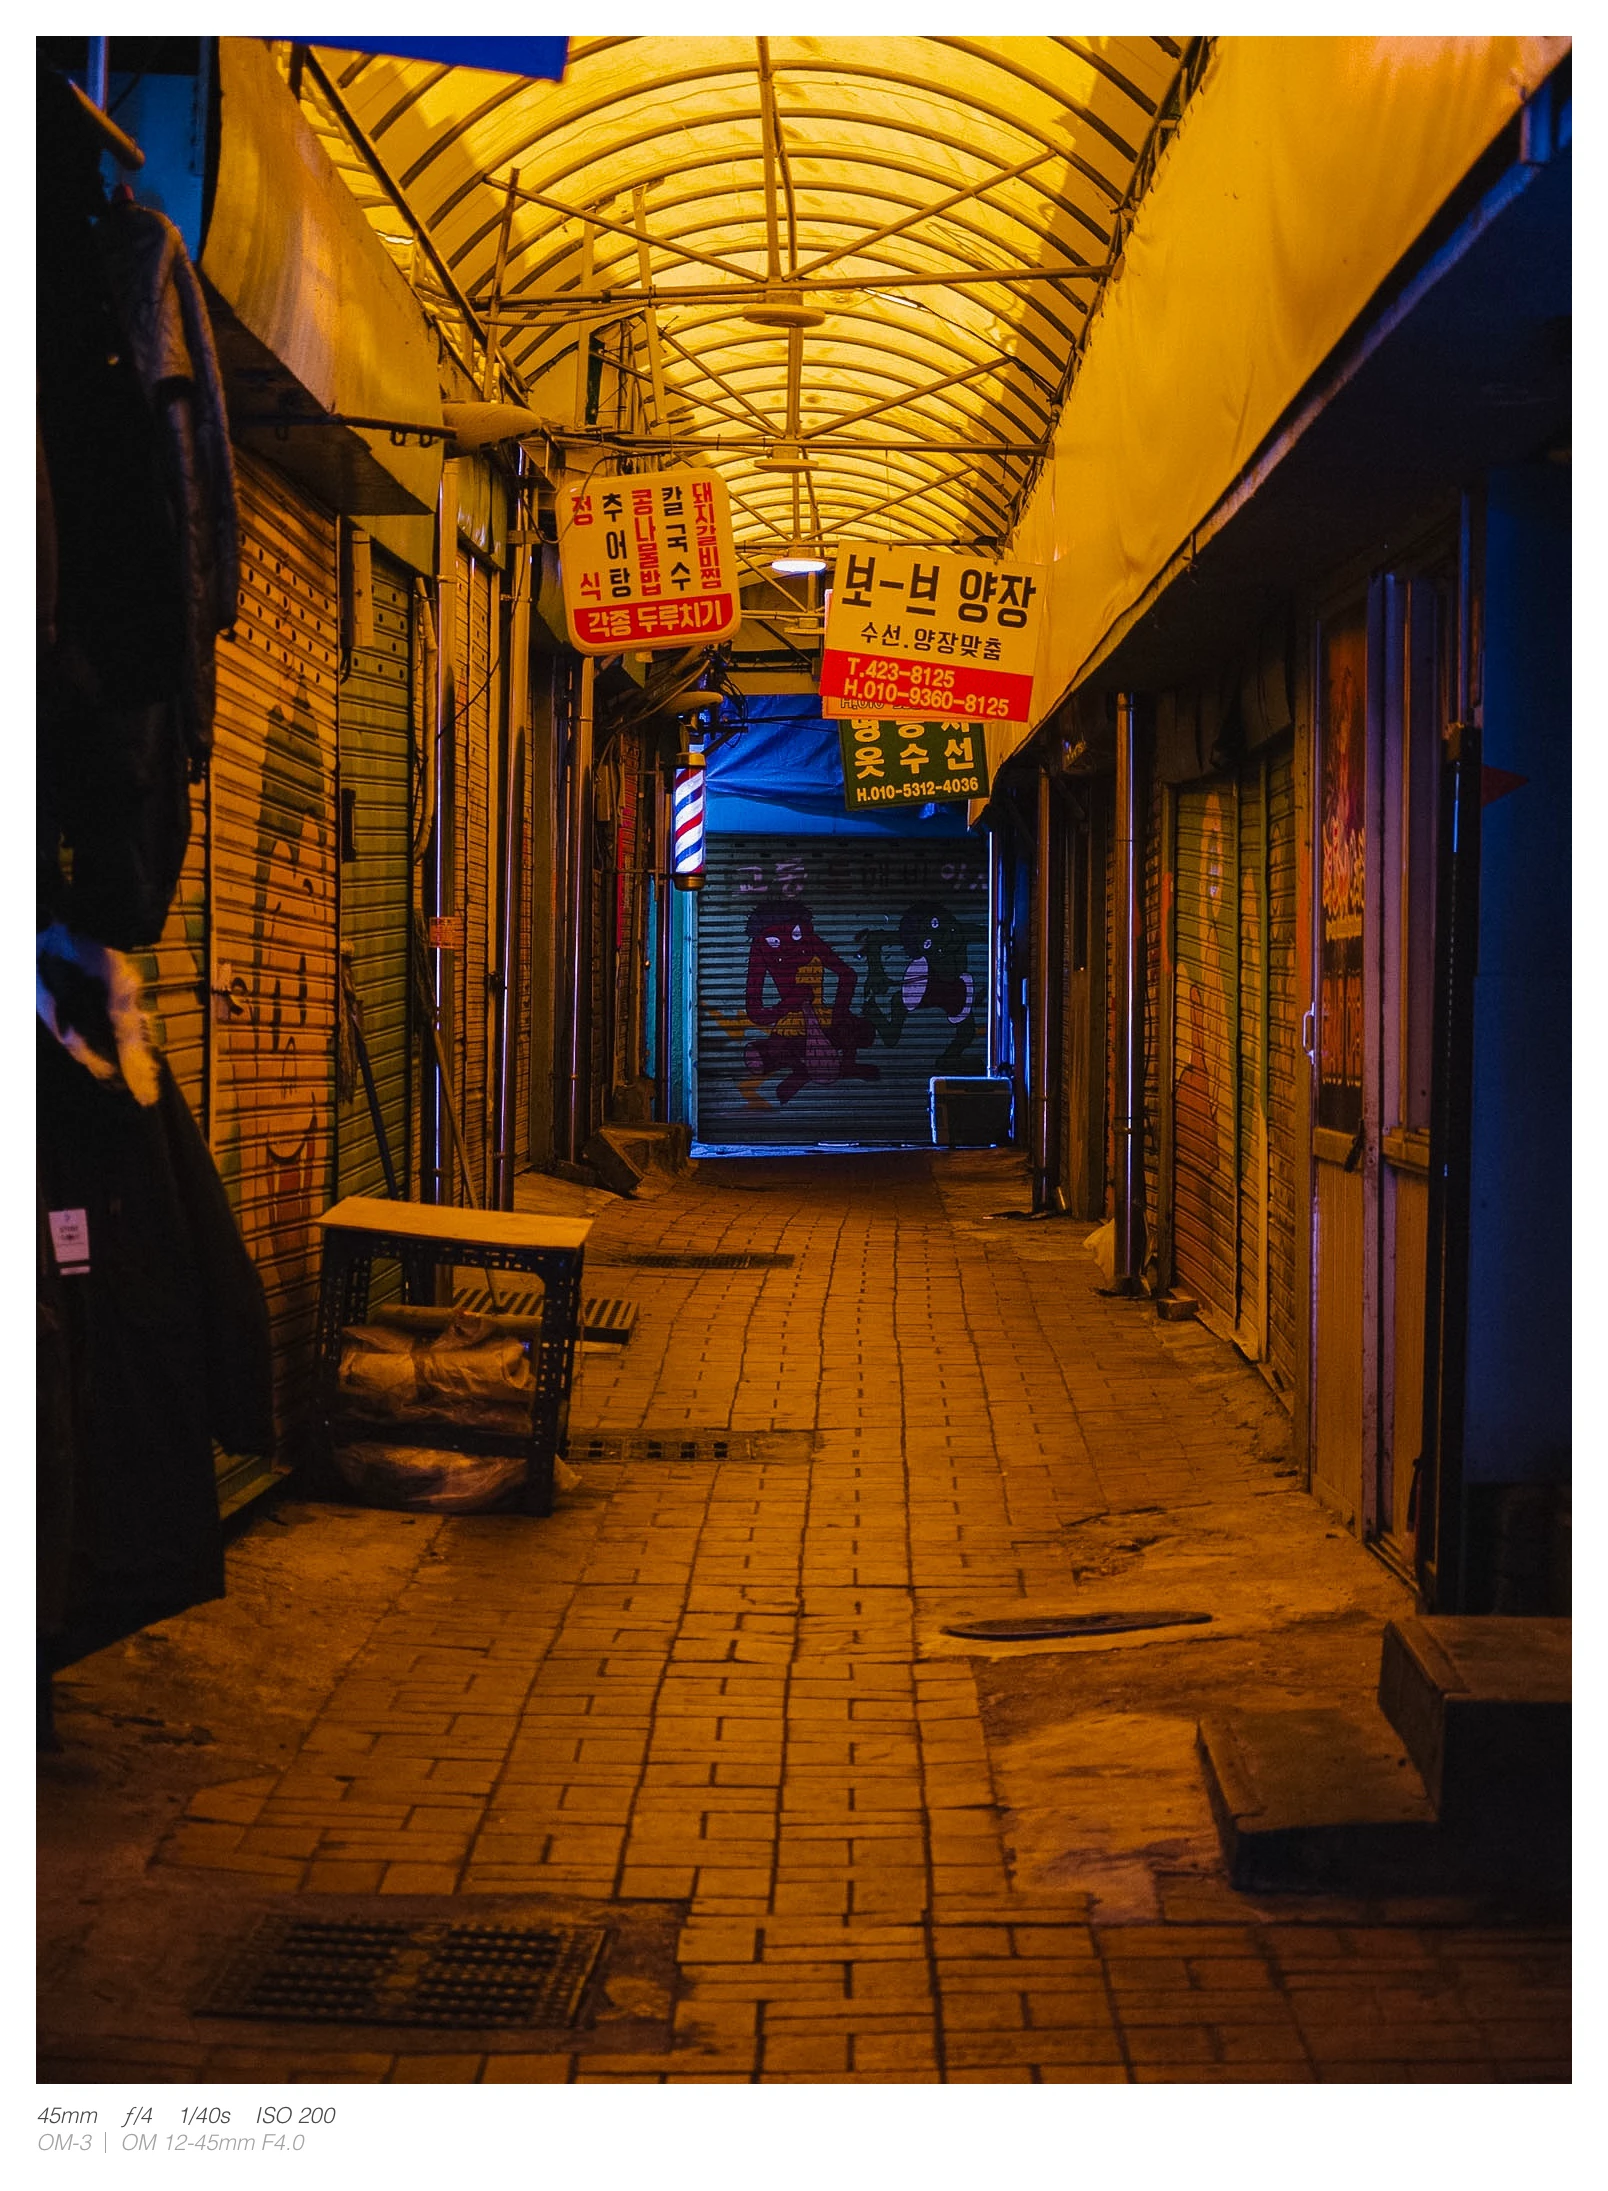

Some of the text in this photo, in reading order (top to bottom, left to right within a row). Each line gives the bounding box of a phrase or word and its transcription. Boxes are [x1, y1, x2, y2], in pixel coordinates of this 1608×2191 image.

[602, 493, 631, 598] 추어탕
[632, 489, 662, 597] 콩나물밥
[661, 486, 691, 591] 칼국수
[692, 482, 722, 590] 돼지갈비찜
[588, 600, 723, 638] 각종 두루치기
[957, 568, 1036, 629] 양장
[843, 678, 1009, 717] H.010-9360-8125
[847, 657, 955, 689] T.423-8125
[856, 777, 979, 802] H.010-5312-4036
